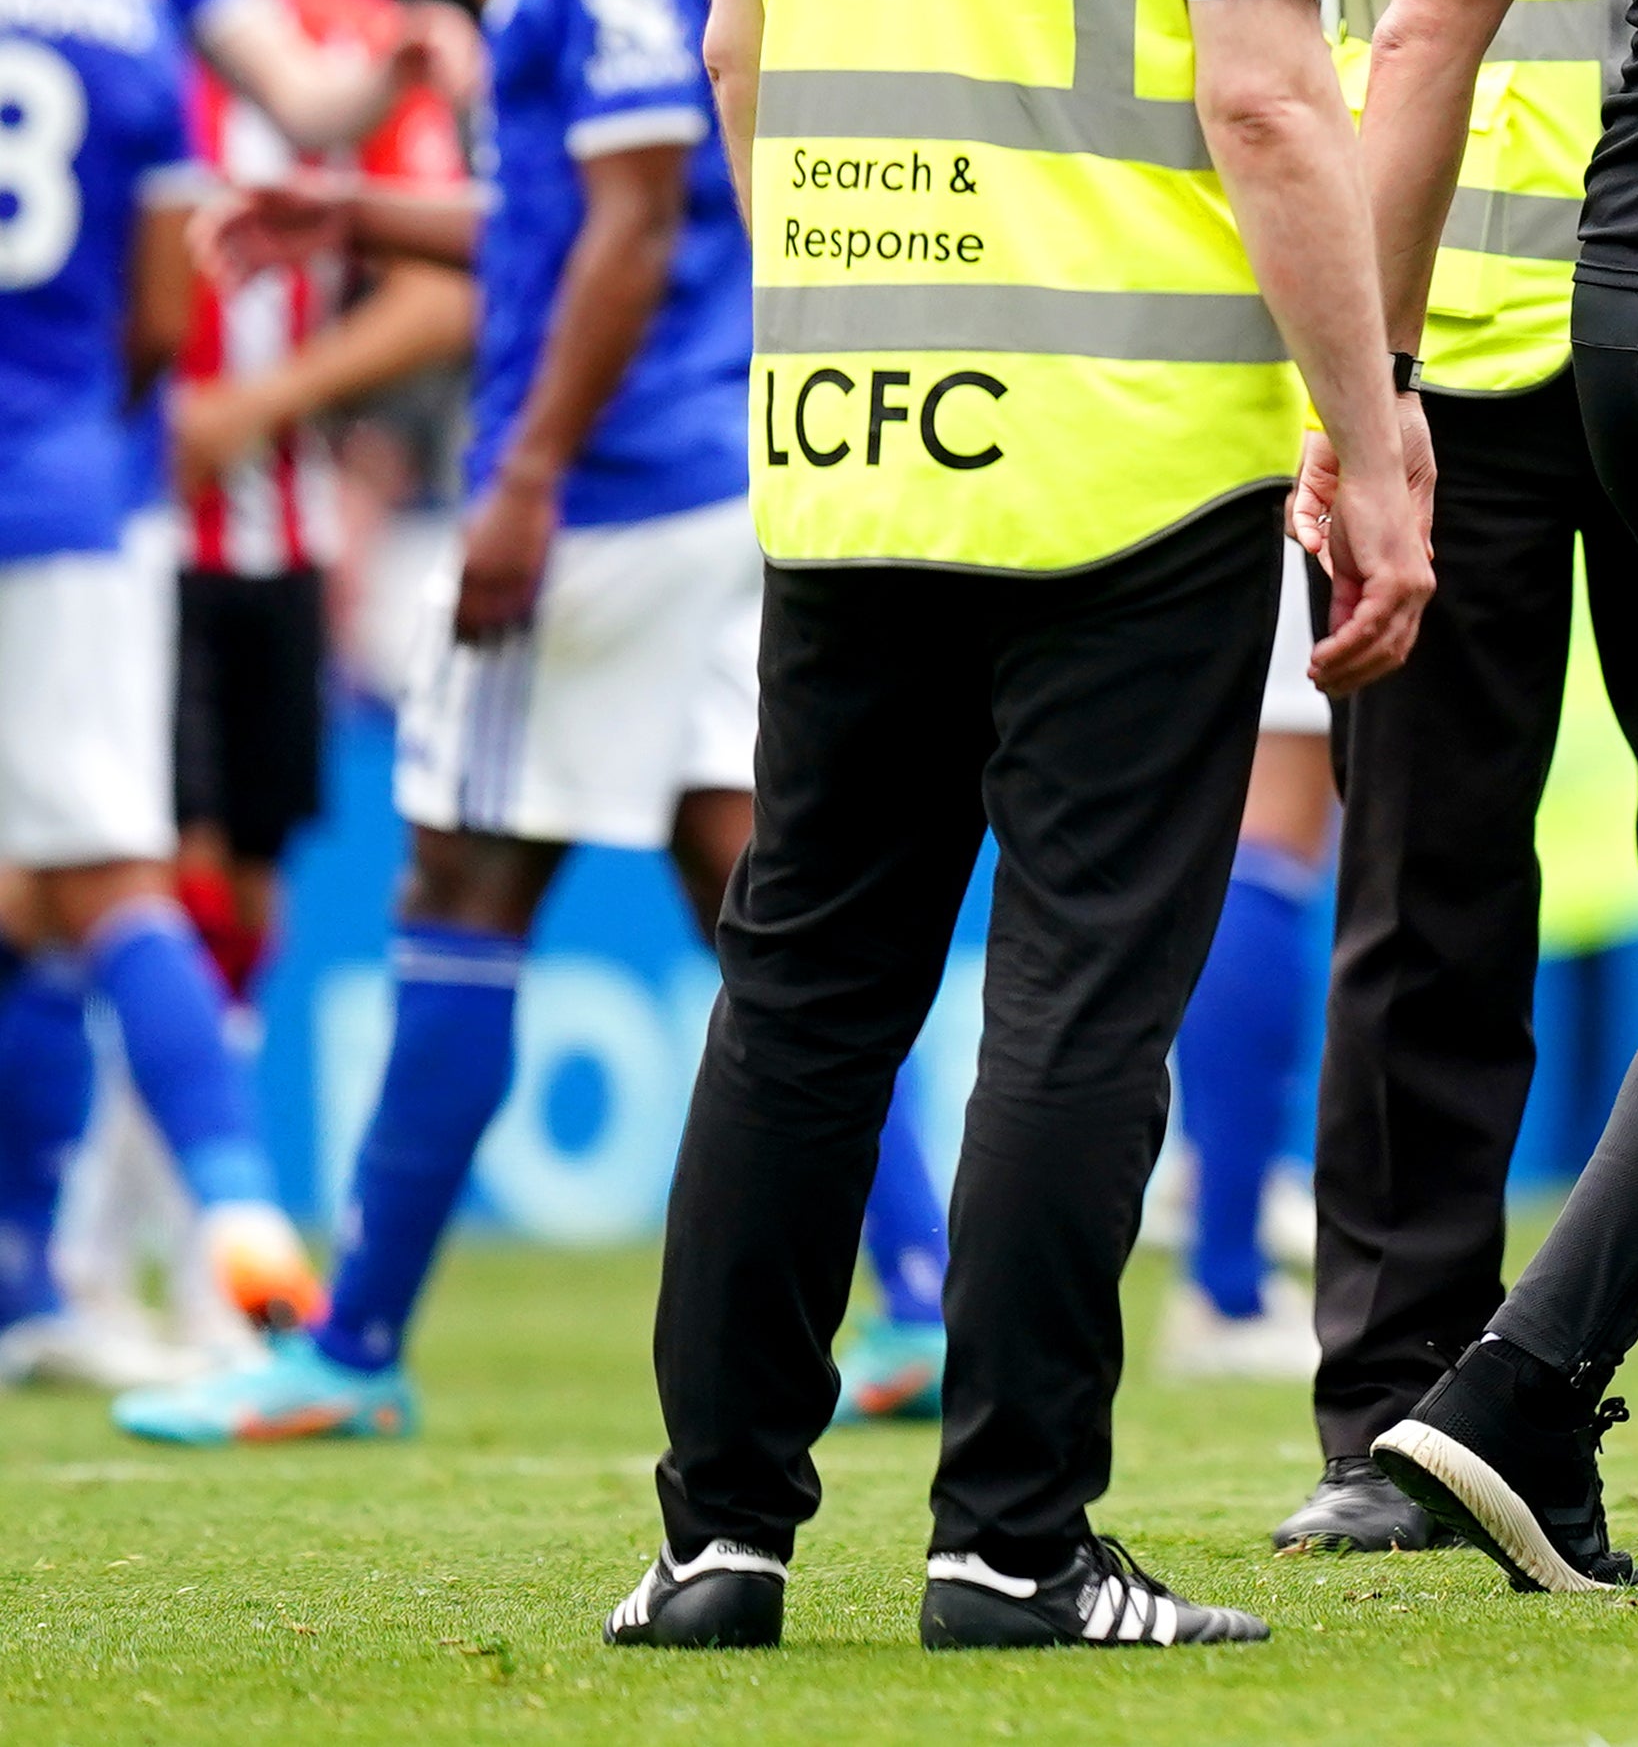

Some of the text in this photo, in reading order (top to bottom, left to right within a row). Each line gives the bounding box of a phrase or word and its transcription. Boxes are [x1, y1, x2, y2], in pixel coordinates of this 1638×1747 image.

[791, 148, 978, 195] Search &
[784, 218, 985, 269] Response
[766, 367, 1009, 470] LCFC
